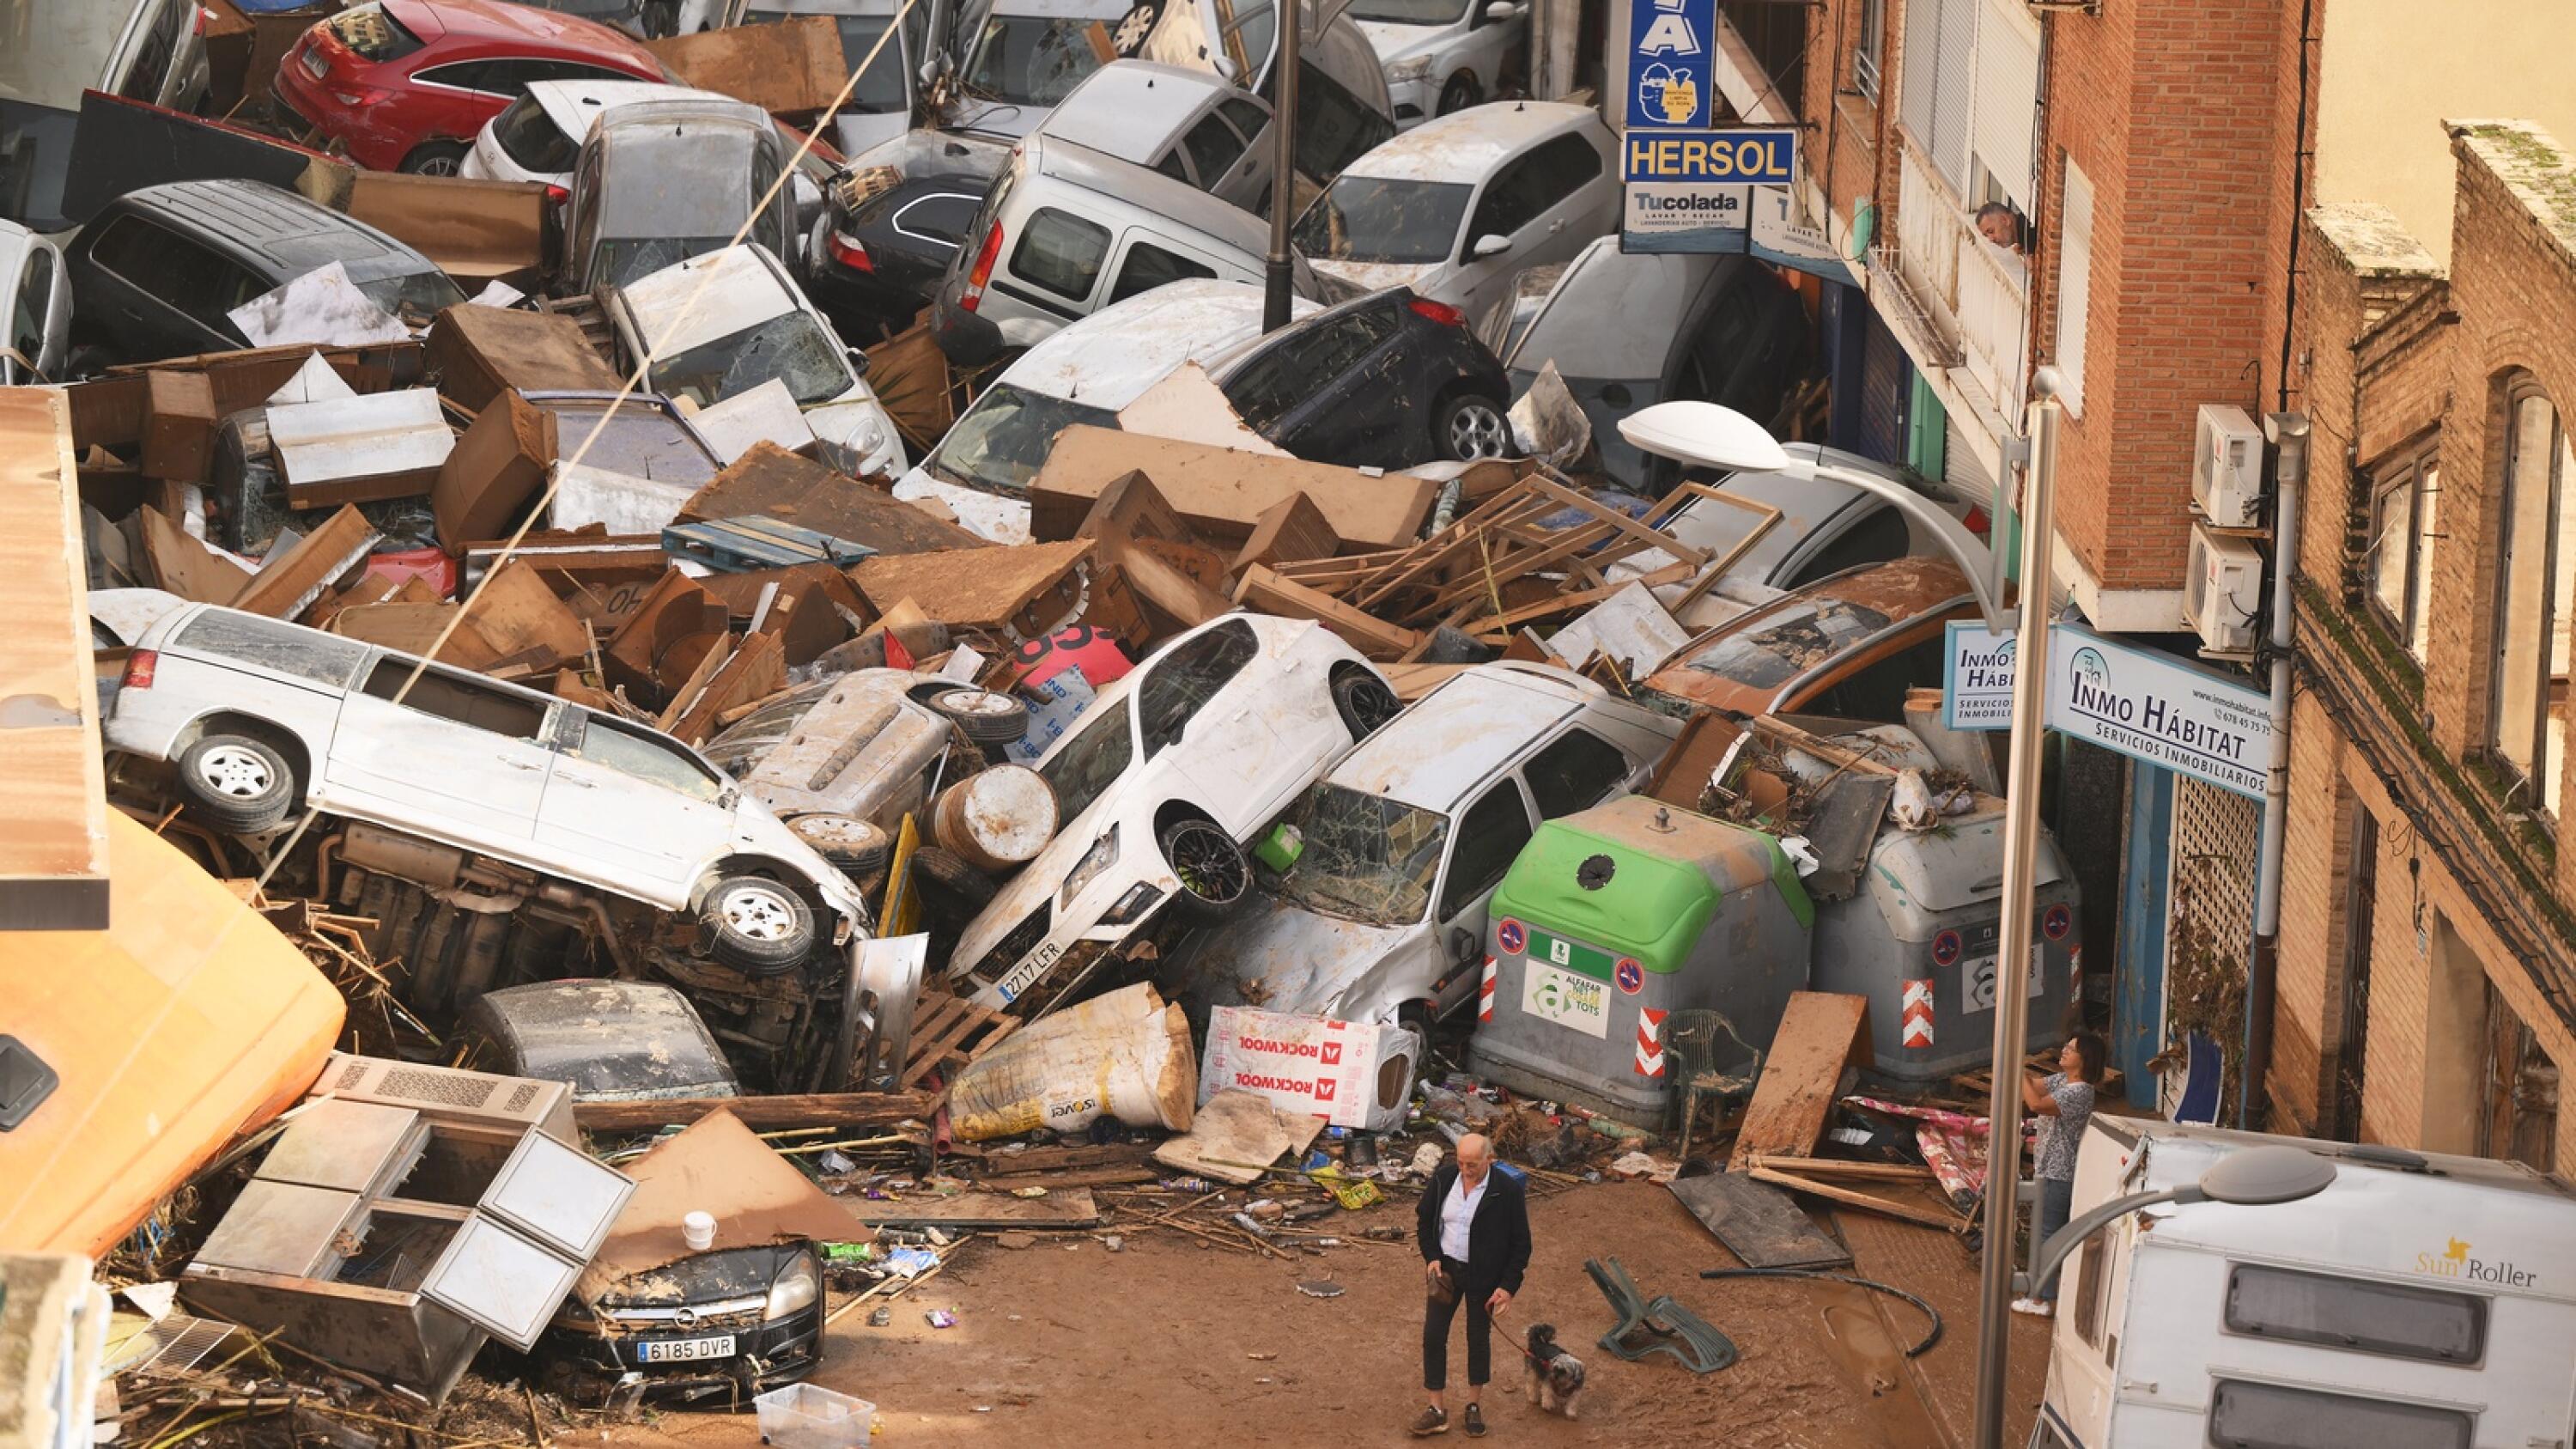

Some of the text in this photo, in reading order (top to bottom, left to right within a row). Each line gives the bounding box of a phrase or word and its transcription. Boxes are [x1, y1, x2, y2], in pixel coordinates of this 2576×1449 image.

[1631, 140, 1788, 176] HERSOL
[1634, 192, 1738, 210] Tucolada
[1960, 649, 2008, 667] INMO
[2071, 671, 2246, 759] INMO HÁBITAT
[2095, 722, 2265, 792] SERVICIOS INMOBILIARIOS
[1005, 942, 1060, 995] 2717 LFR
[1238, 1036, 1319, 1057] ROCKWOOL
[1236, 1073, 1313, 1093] ROCKWOOL
[2415, 1251, 2537, 1288] Sun Roller
[652, 1339, 730, 1359] 6185 DVR
